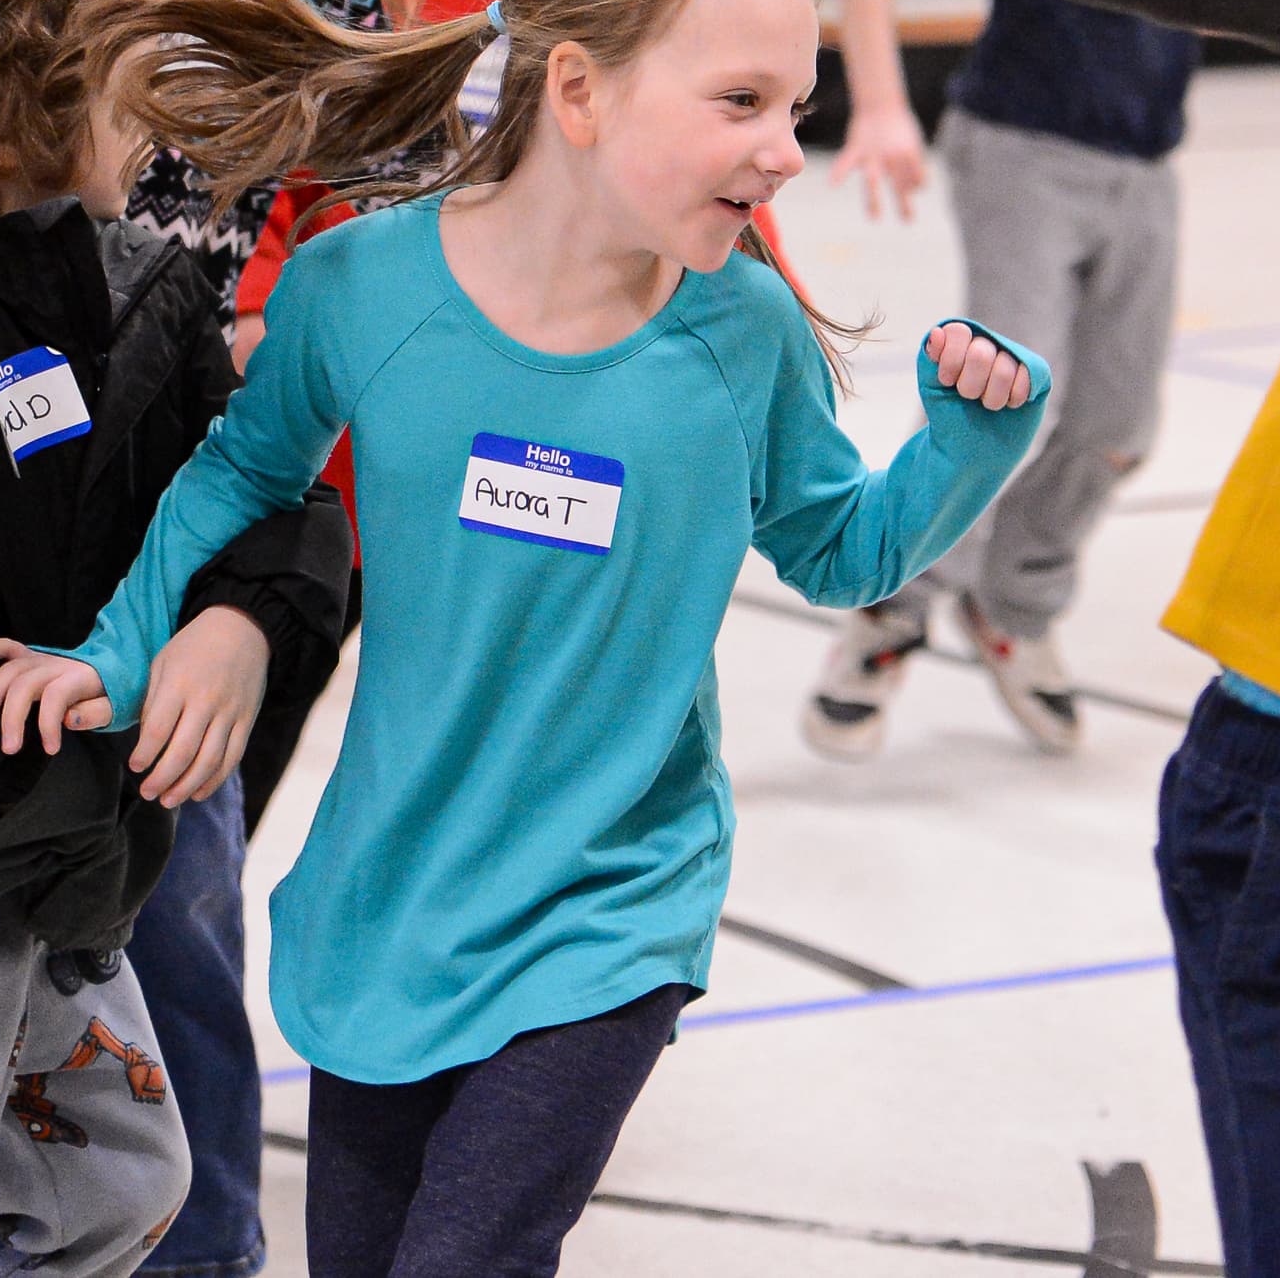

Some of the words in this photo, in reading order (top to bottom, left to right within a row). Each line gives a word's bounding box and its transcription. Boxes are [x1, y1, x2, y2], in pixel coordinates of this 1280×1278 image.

[25, 394, 51, 420] D
[526, 444, 571, 467] Hello
[540, 464, 564, 474] name
[475, 477, 550, 519] Aurora
[556, 495, 588, 525] T
